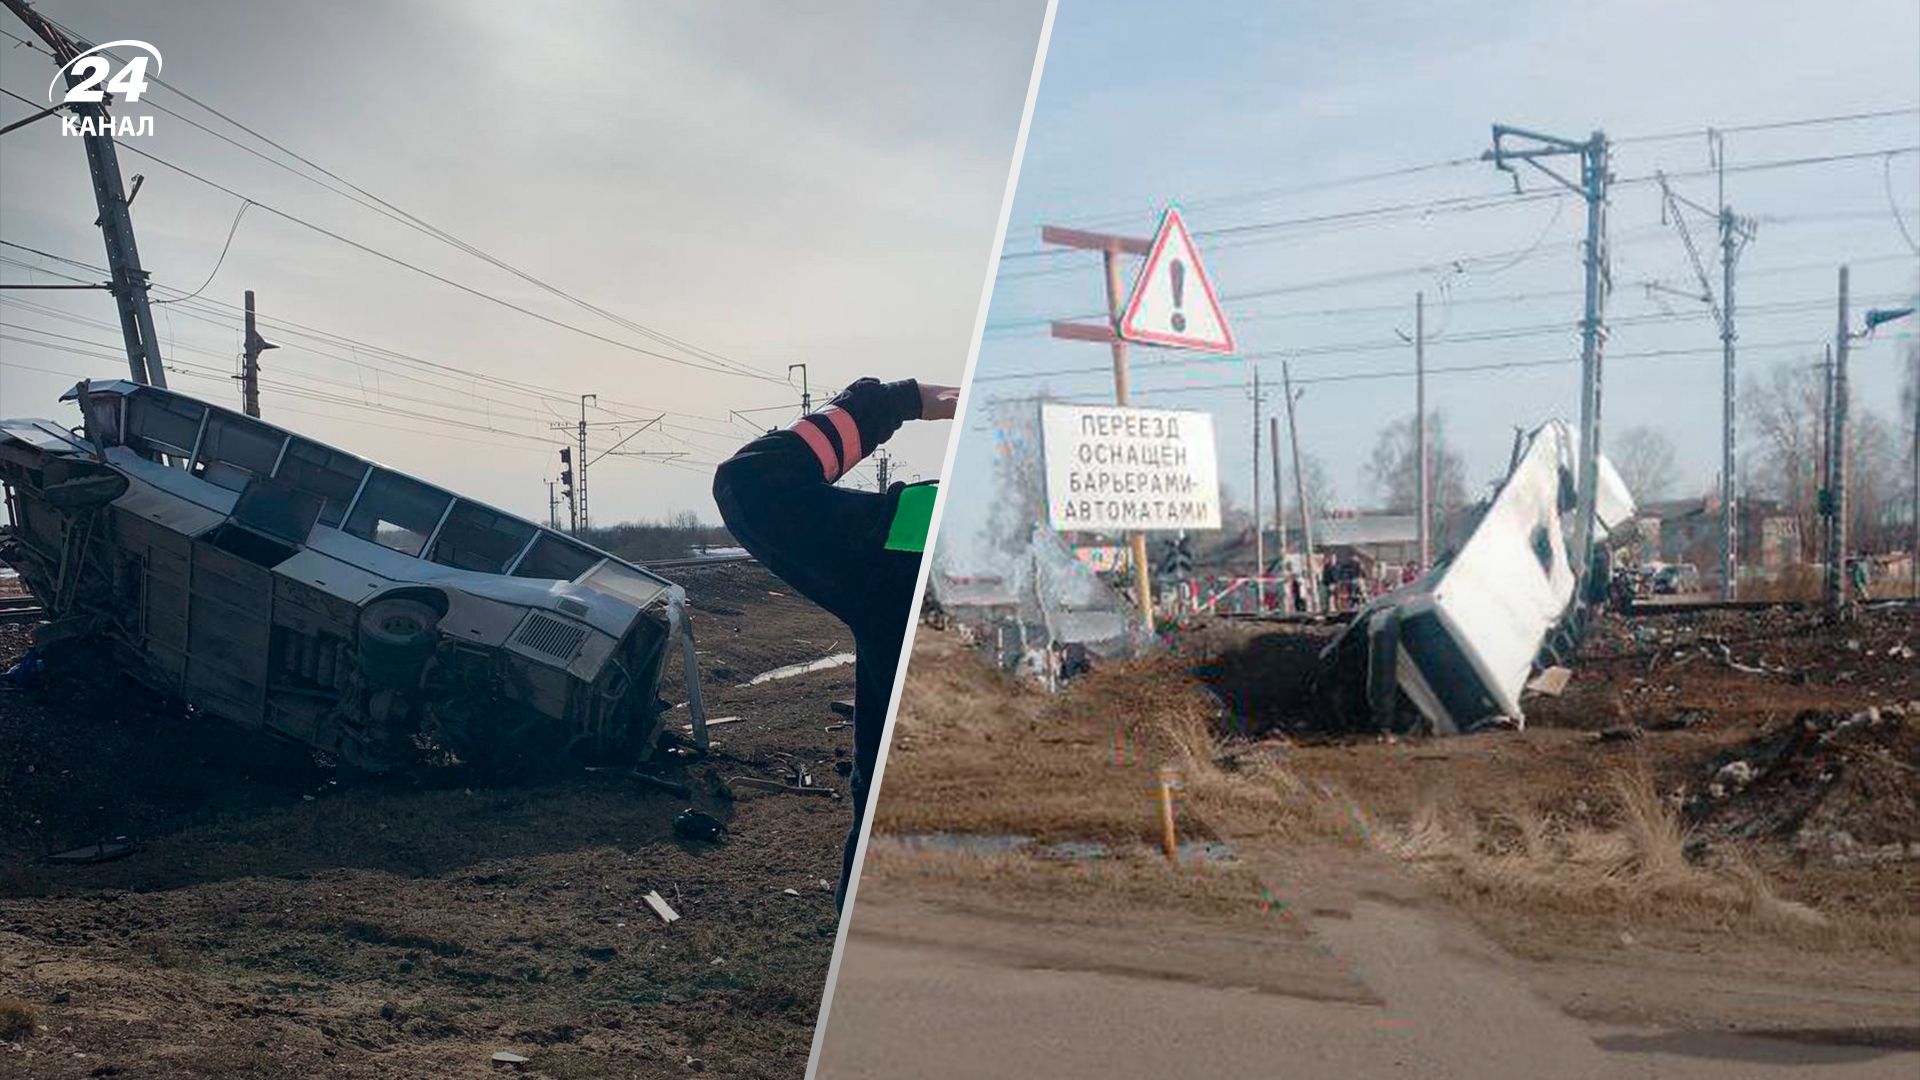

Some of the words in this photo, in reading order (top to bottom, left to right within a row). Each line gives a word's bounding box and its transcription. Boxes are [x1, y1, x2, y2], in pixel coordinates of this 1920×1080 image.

[1081, 414, 1180, 438] ПЕРЕЕЗД
[1078, 443, 1187, 468] ОСНАЩЕН
[1069, 472, 1198, 494] БАРЬЕРАМИ-
[1065, 500, 1208, 521] АВТОМАТАМИ
